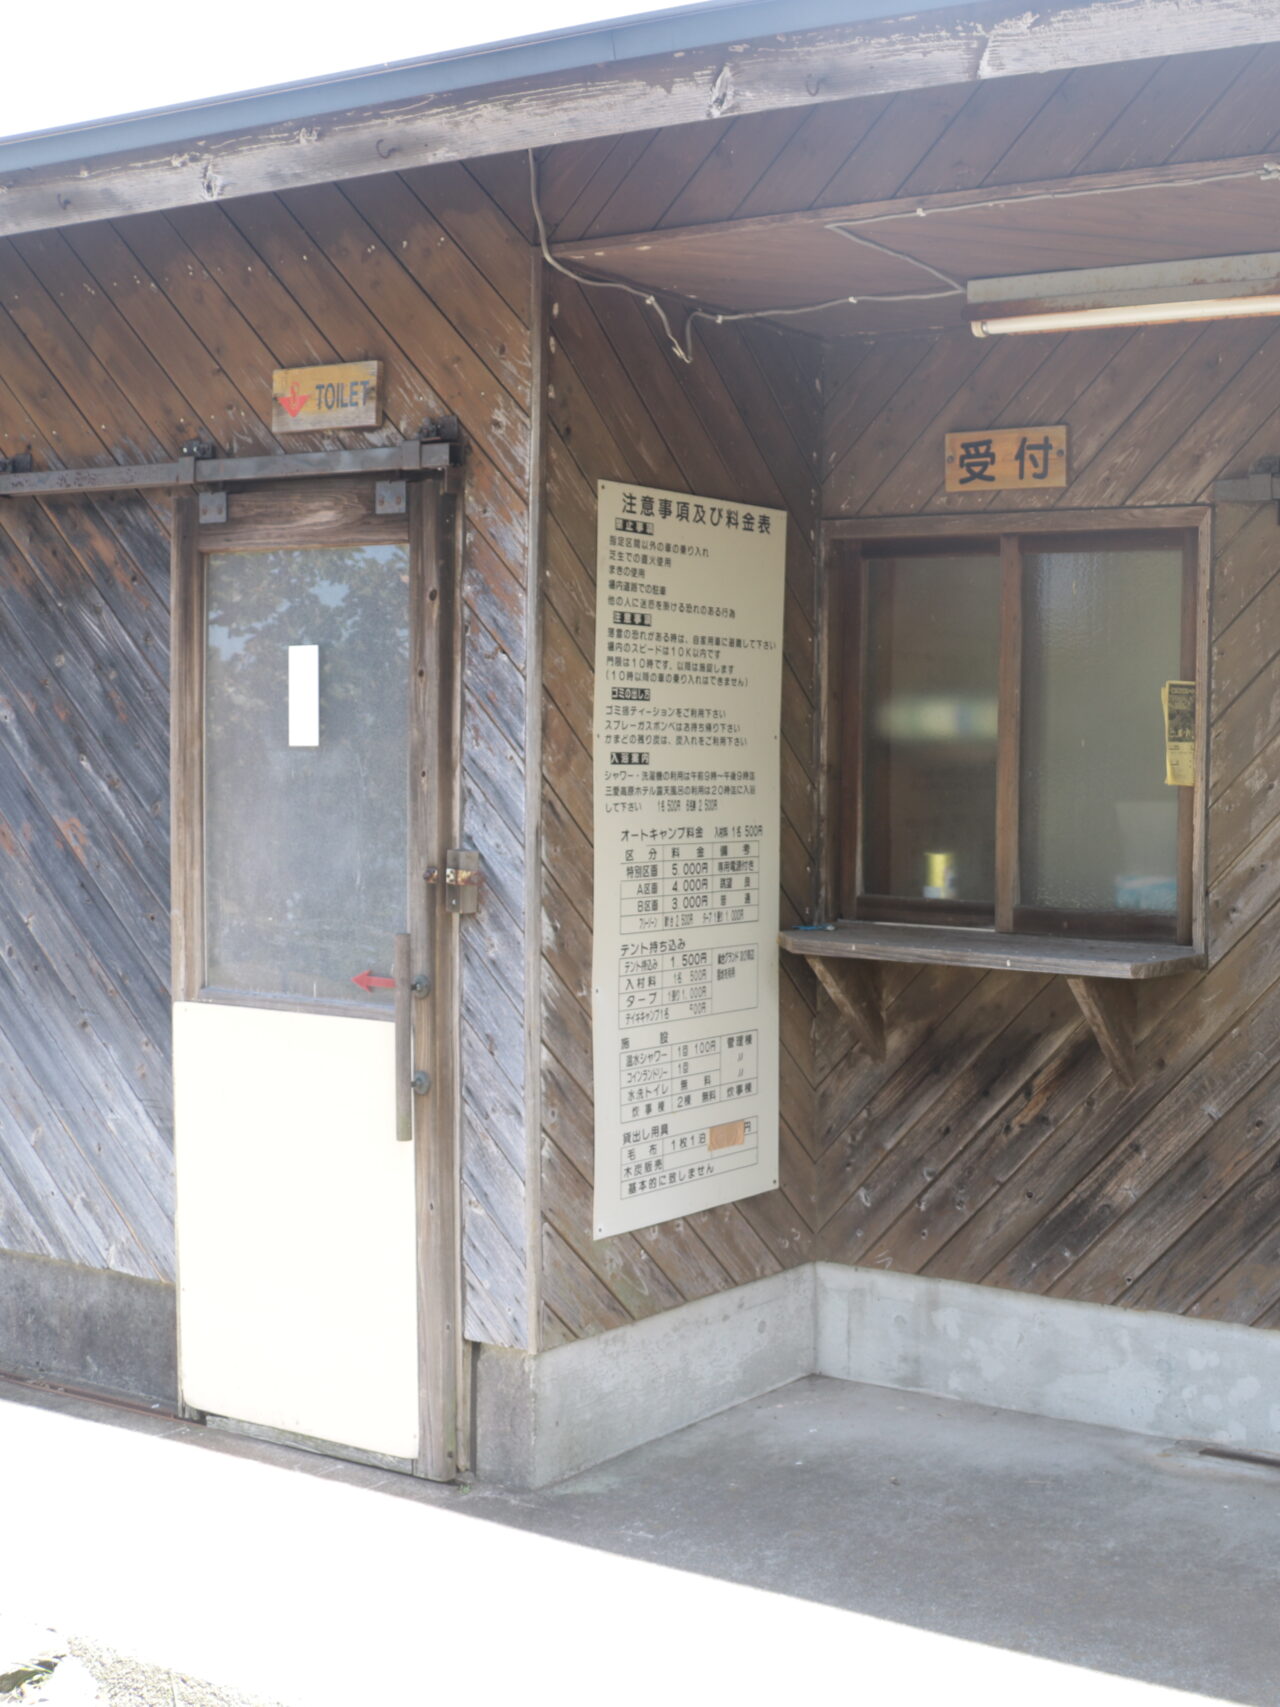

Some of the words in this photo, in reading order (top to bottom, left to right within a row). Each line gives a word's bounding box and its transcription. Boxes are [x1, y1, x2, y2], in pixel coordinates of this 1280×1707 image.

[315, 380, 370, 410] TOILET
[959, 435, 1053, 484] 受付
[622, 492, 772, 535] 注意事項及び料金表
[605, 802, 642, 813] して下さい
[621, 826, 704, 842] オートキャンプ料金
[626, 864, 658, 879] 特別区画
[621, 938, 686, 957] テント持ち込み
[626, 992, 657, 1008] タープ
[626, 1050, 667, 1068] 温水シャワー
[627, 1084, 668, 1102] 水洗トイレ
[623, 1124, 668, 1145] 貸出し用具
[628, 1165, 714, 1195] 基本的に致しません
